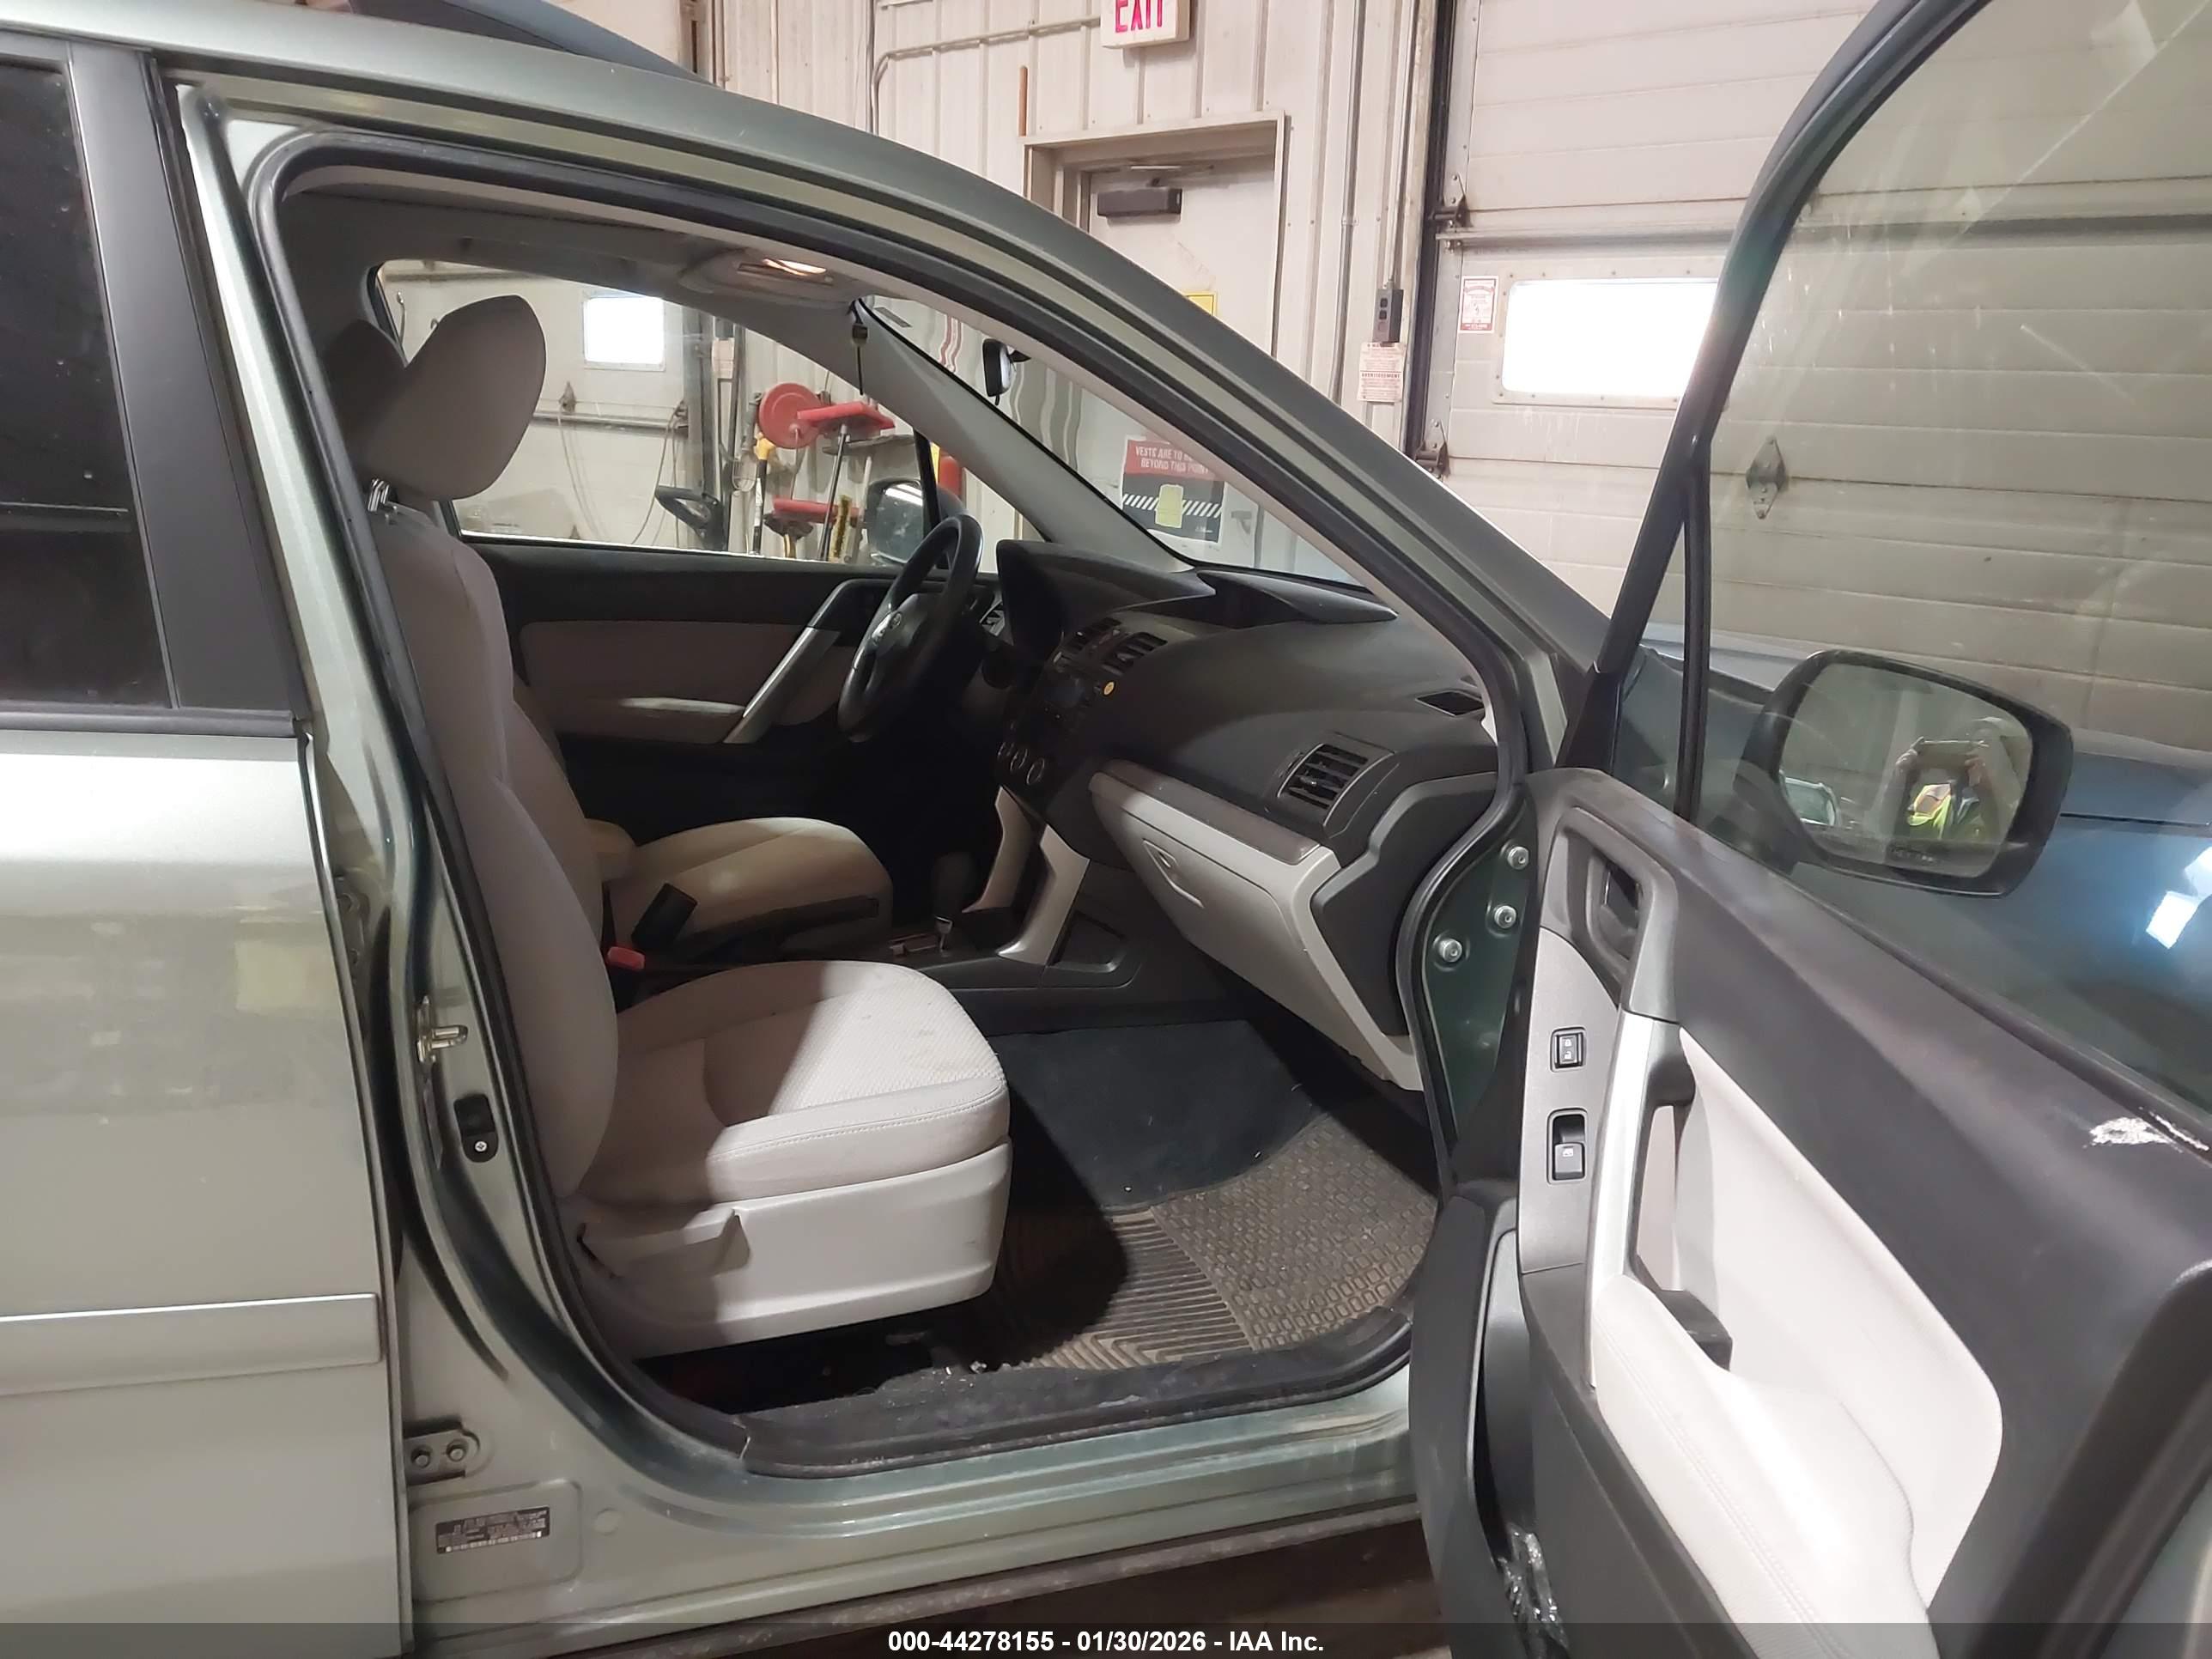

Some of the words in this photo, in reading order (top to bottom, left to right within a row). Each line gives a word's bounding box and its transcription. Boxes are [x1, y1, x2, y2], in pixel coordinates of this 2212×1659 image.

[1158, 447, 1172, 459] ARE
[1173, 450, 1183, 460] TO
[1140, 457, 1169, 470] BEYOND
